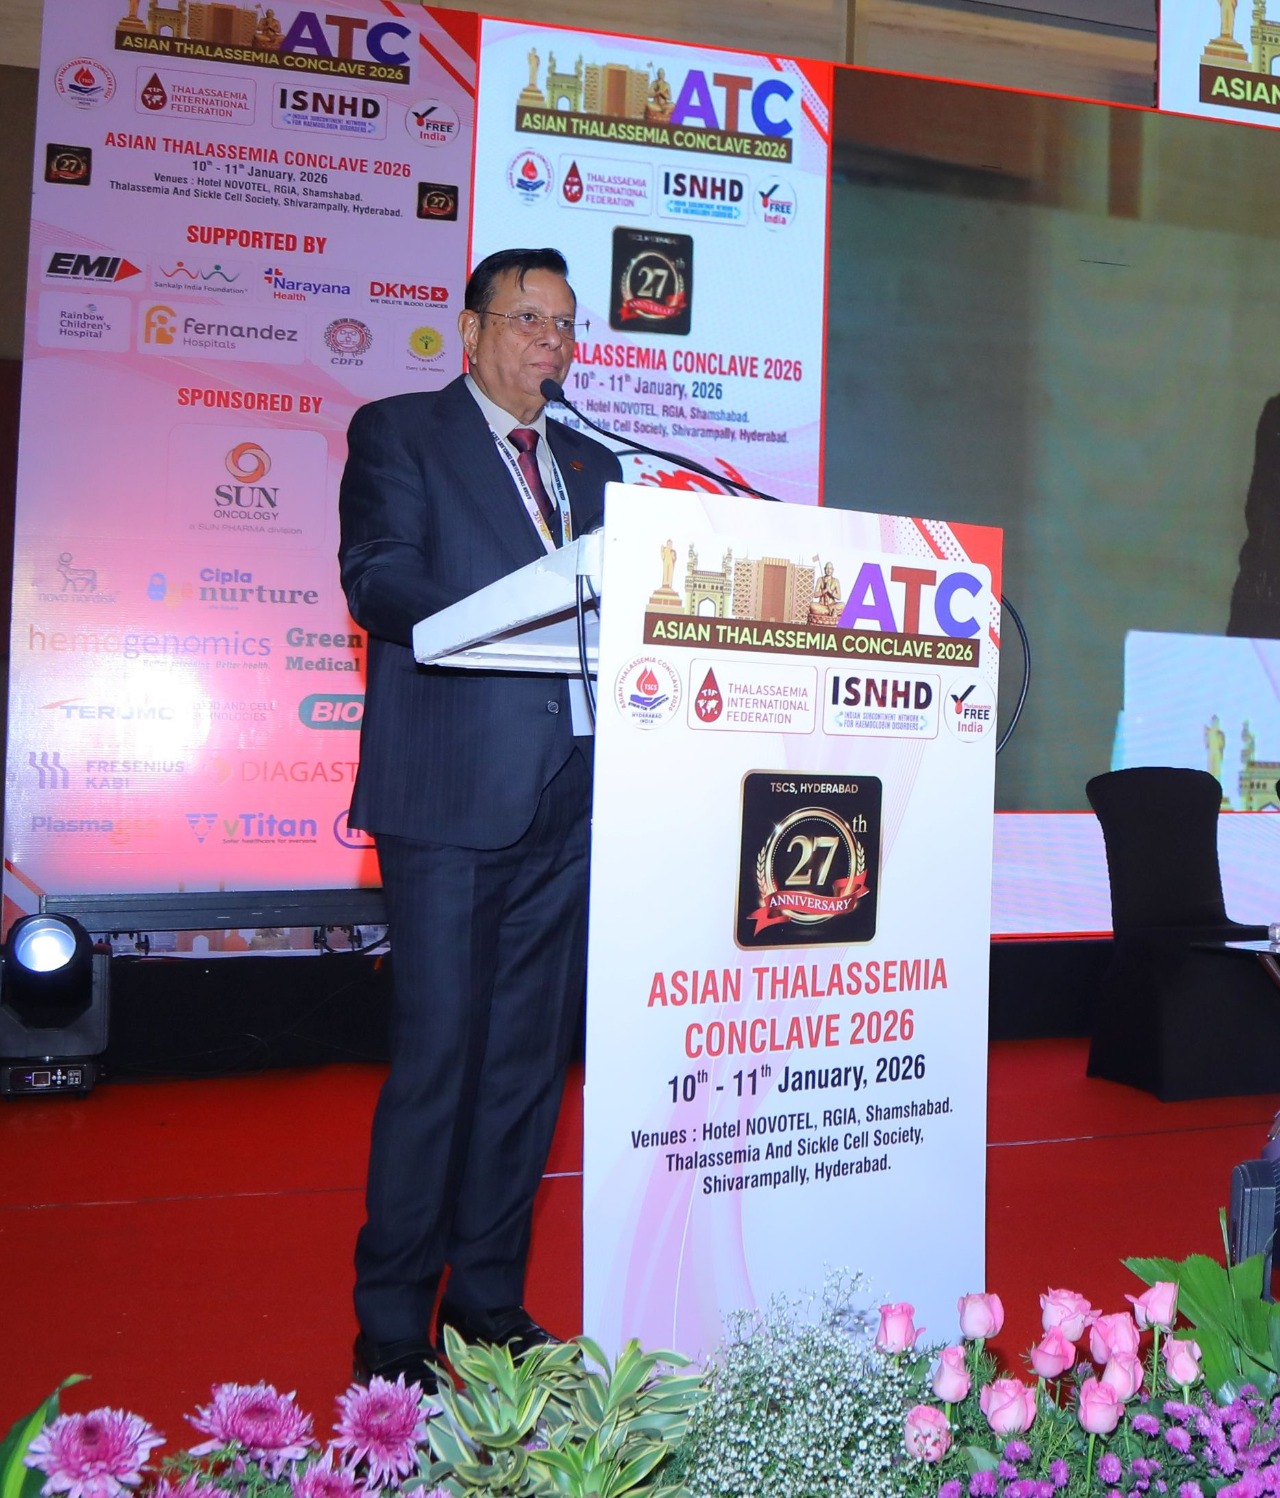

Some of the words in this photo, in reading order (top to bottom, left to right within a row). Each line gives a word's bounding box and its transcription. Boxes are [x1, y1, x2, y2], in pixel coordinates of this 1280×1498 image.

[279, 10, 412, 65] ATC
[122, 35, 170, 52] ASIAN
[174, 42, 279, 66] THALASSEMIA
[283, 55, 366, 76] CONCLAVE
[369, 66, 404, 81] 2026
[171, 84, 248, 101] THALASSAEMIA
[171, 94, 250, 111] INTERNATIONAL
[170, 103, 233, 118] FEDERATION
[279, 88, 380, 119] ISNHD
[669, 69, 795, 138] ATC
[420, 131, 446, 142] India
[521, 112, 567, 134] ASIAN
[570, 117, 670, 146] THALASSEMIA
[673, 131, 752, 155] CONCLAVE
[754, 141, 788, 160] 2026
[105, 132, 156, 151] ASIAN
[162, 137, 279, 164] THALASSEMIA
[284, 151, 368, 173] CONCLAVE
[373, 160, 411, 178] 2026
[154, 172, 188, 185] Venues
[197, 177, 222, 188] Hotel
[224, 179, 271, 194] NOVOTEL,
[274, 184, 299, 197] RGIA,
[302, 187, 363, 202] Shamshabad.
[663, 171, 744, 203] ISNHD
[109, 180, 169, 195] Thalassemia
[172, 186, 191, 197] And
[193, 189, 222, 200] Sickle
[224, 191, 242, 202] Cell
[244, 194, 281, 207] Society,
[283, 198, 350, 214] Shivarampally,
[352, 205, 403, 218] Hyderabad.
[769, 203, 792, 214] FREE
[187, 224, 297, 252] SUPPORTED
[303, 235, 327, 254] BY
[46, 252, 121, 278] EMI
[273, 291, 306, 301] Health
[274, 277, 350, 295] Narayana
[370, 281, 430, 300] DKMS
[59, 319, 111, 331] Children's
[60, 310, 104, 321] Rainbow
[59, 329, 102, 339] Hospital
[183, 337, 236, 349] Hospitals
[330, 357, 364, 367] CDFD
[572, 342, 667, 371] ALASSEMIA
[672, 350, 759, 378] CONCLAVE
[763, 358, 802, 381] 2026
[177, 387, 293, 413] SPONSORED
[298, 395, 323, 414] BY
[214, 483, 280, 510] SUN
[213, 508, 280, 521] ONCOLOGY
[200, 567, 252, 584] Cipla
[199, 586, 319, 606] nurture
[837, 562, 983, 639] ATC
[285, 627, 363, 649] Green
[652, 620, 711, 642] ASIAN
[715, 624, 838, 653] THALASSEMIA
[841, 635, 933, 659] CONCLAVE
[936, 641, 973, 661] 2026
[285, 656, 361, 672] Medical
[728, 683, 808, 698] THALASSAEMIA
[831, 676, 933, 710] ISNHD
[727, 697, 810, 712] INTERNATIONAL
[964, 709, 990, 720] FREE
[726, 711, 792, 724] FEDERATION
[843, 719, 853, 728] FOR
[891, 721, 919, 731] DISORDERS
[844, 711, 861, 720] INDIAN
[862, 712, 896, 721] SUBCONTINENT
[898, 713, 919, 722] NETWORK
[957, 721, 983, 733] India
[770, 782, 798, 795] TSCS,
[800, 783, 859, 794] HYDERABAD
[222, 812, 317, 837] vTitan
[785, 834, 840, 886] 27
[769, 896, 852, 911] ANNIVERSARY
[647, 967, 742, 1007] ASIAN
[752, 957, 948, 1002] THALASSEMIA
[684, 1012, 840, 1059] CONCLAVE
[849, 1008, 915, 1045] 2026
[667, 1068, 708, 1103] 10th
[733, 1064, 772, 1097] 11th
[777, 1063, 868, 1094] January,
[875, 1054, 926, 1084] 2026
[631, 1127, 687, 1149] Venues
[702, 1118, 741, 1142] Hotel
[745, 1111, 818, 1137] NOVOTEL,
[822, 1106, 861, 1128] RGIA,
[865, 1096, 953, 1123] Shamshabad.
[665, 1143, 761, 1173] Thalassemia
[765, 1138, 793, 1161] And
[797, 1132, 840, 1157] Sickle
[843, 1127, 870, 1151] Cell
[873, 1125, 924, 1147] Society,
[703, 1164, 810, 1195] Shivarampally,
[814, 1153, 892, 1183] Hyderabad.
